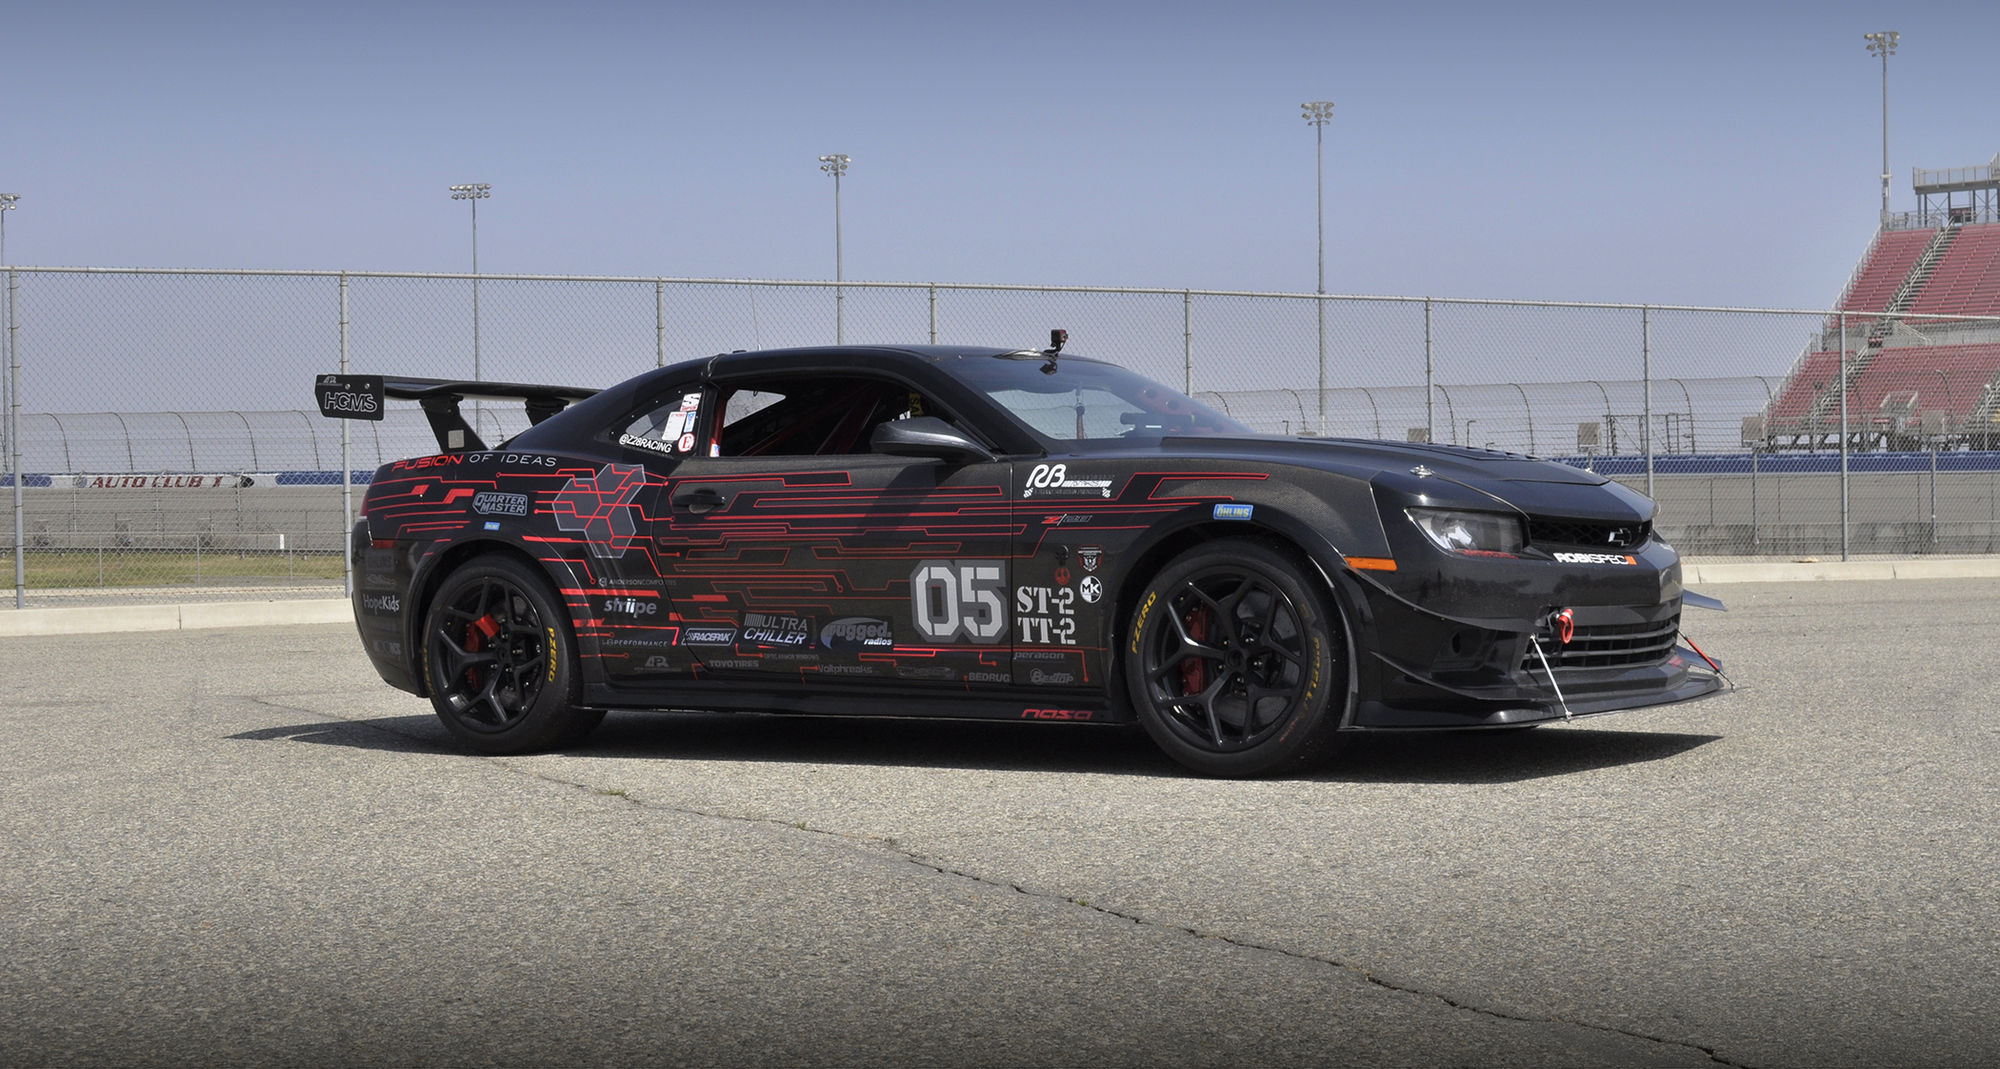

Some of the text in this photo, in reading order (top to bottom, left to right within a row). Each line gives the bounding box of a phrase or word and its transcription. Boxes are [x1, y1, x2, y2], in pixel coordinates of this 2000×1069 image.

[618, 433, 673, 453] @Z28RACING
[391, 453, 558, 472] FUSION OF IDEAS
[89, 476, 147, 488] AUTO
[151, 476, 203, 488] CLUB
[474, 494, 526, 506] QUARTER
[480, 502, 525, 514] MASTER
[1552, 552, 1629, 565] ROBISPEC
[1082, 583, 1101, 594] MK
[362, 594, 400, 615] HopeKids
[914, 564, 1005, 639] 05
[1016, 585, 1075, 615] ST-2
[761, 614, 809, 632] ULTRA
[692, 632, 732, 642] RACEPAK
[743, 627, 808, 645] CHILLER
[1017, 616, 1077, 645] TT-2
[863, 637, 893, 647] radios
[709, 659, 760, 669] TOYO TIRES
[968, 671, 1011, 683] BEDRUG
[1021, 708, 1093, 721] nasa
